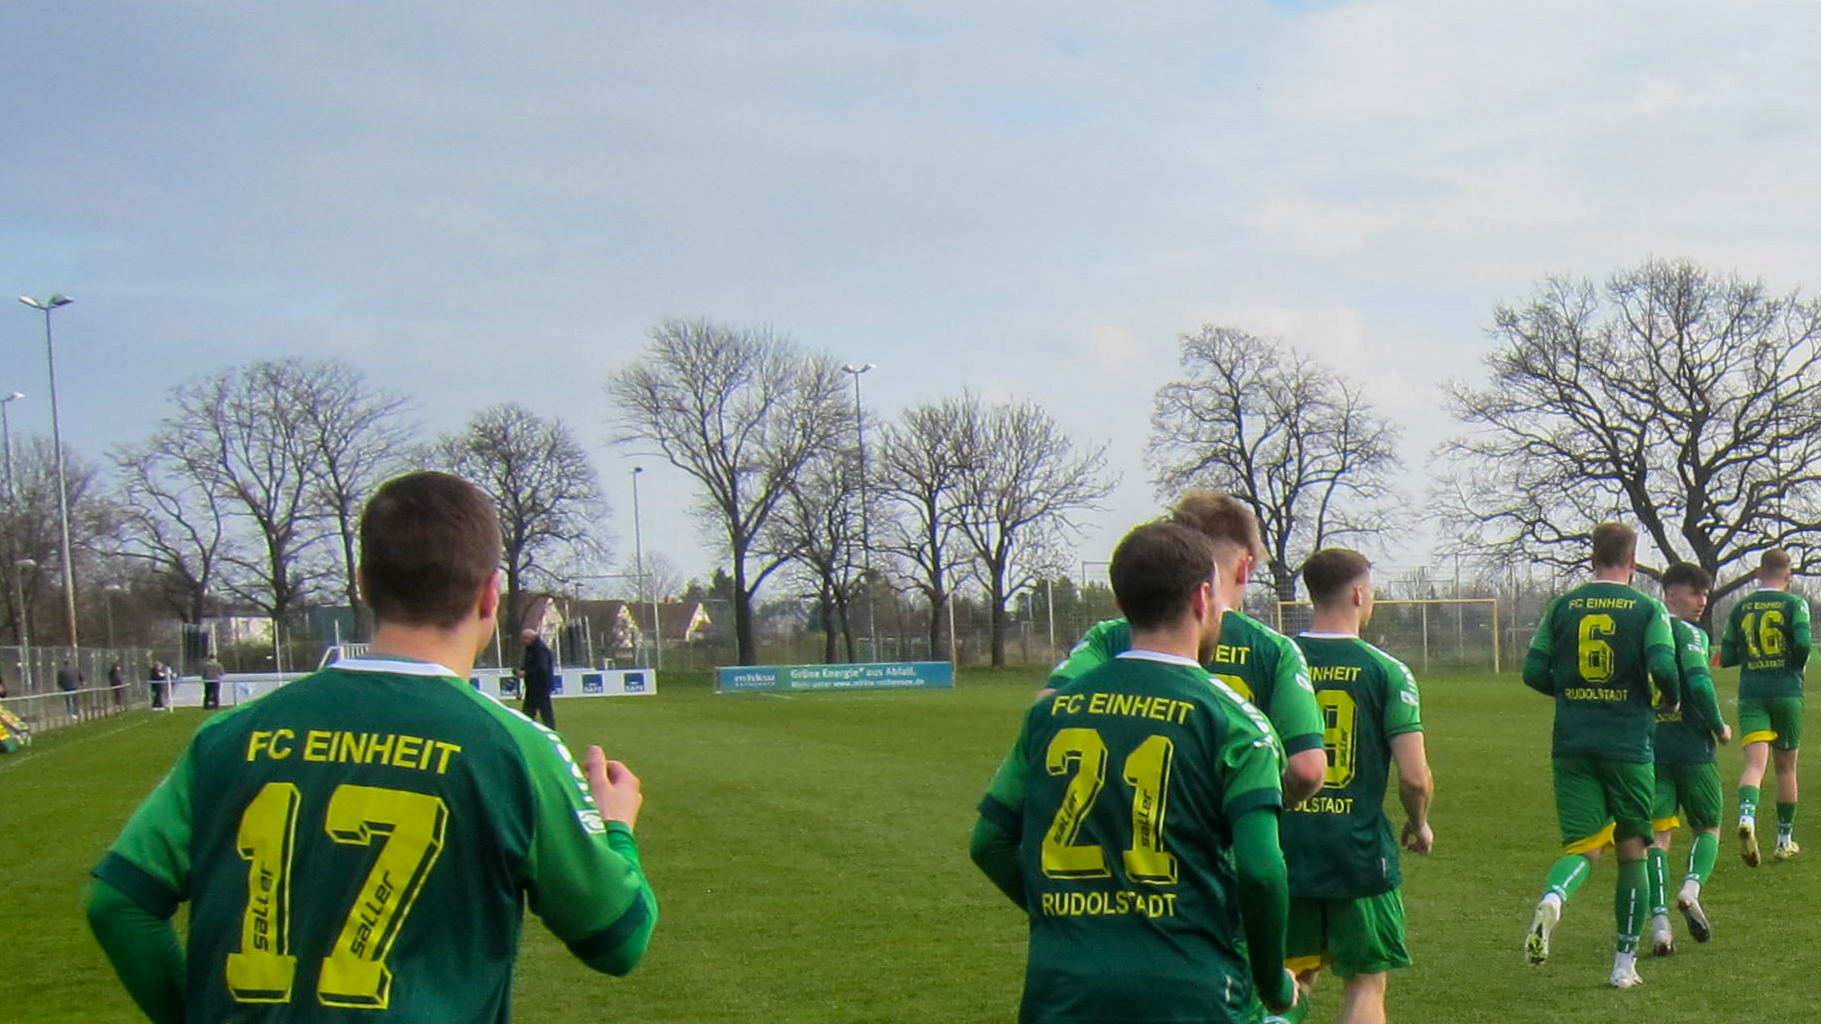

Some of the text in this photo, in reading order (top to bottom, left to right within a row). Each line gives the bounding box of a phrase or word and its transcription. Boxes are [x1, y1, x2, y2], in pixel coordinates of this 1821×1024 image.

[1586, 597, 1637, 609] EINHEIT
[1578, 613, 1616, 683] 6
[1741, 610, 1786, 658] 16
[1309, 666, 1362, 682] INHEIT
[1051, 692, 1196, 725] FC EINHEIT
[247, 728, 461, 774] FC EINHEIT
[1041, 727, 1179, 886] 21
[1294, 796, 1354, 815] LSTADT
[226, 782, 449, 1010] 17
[349, 870, 398, 958] saller
[1041, 891, 1178, 918] RUDOLSTADT
